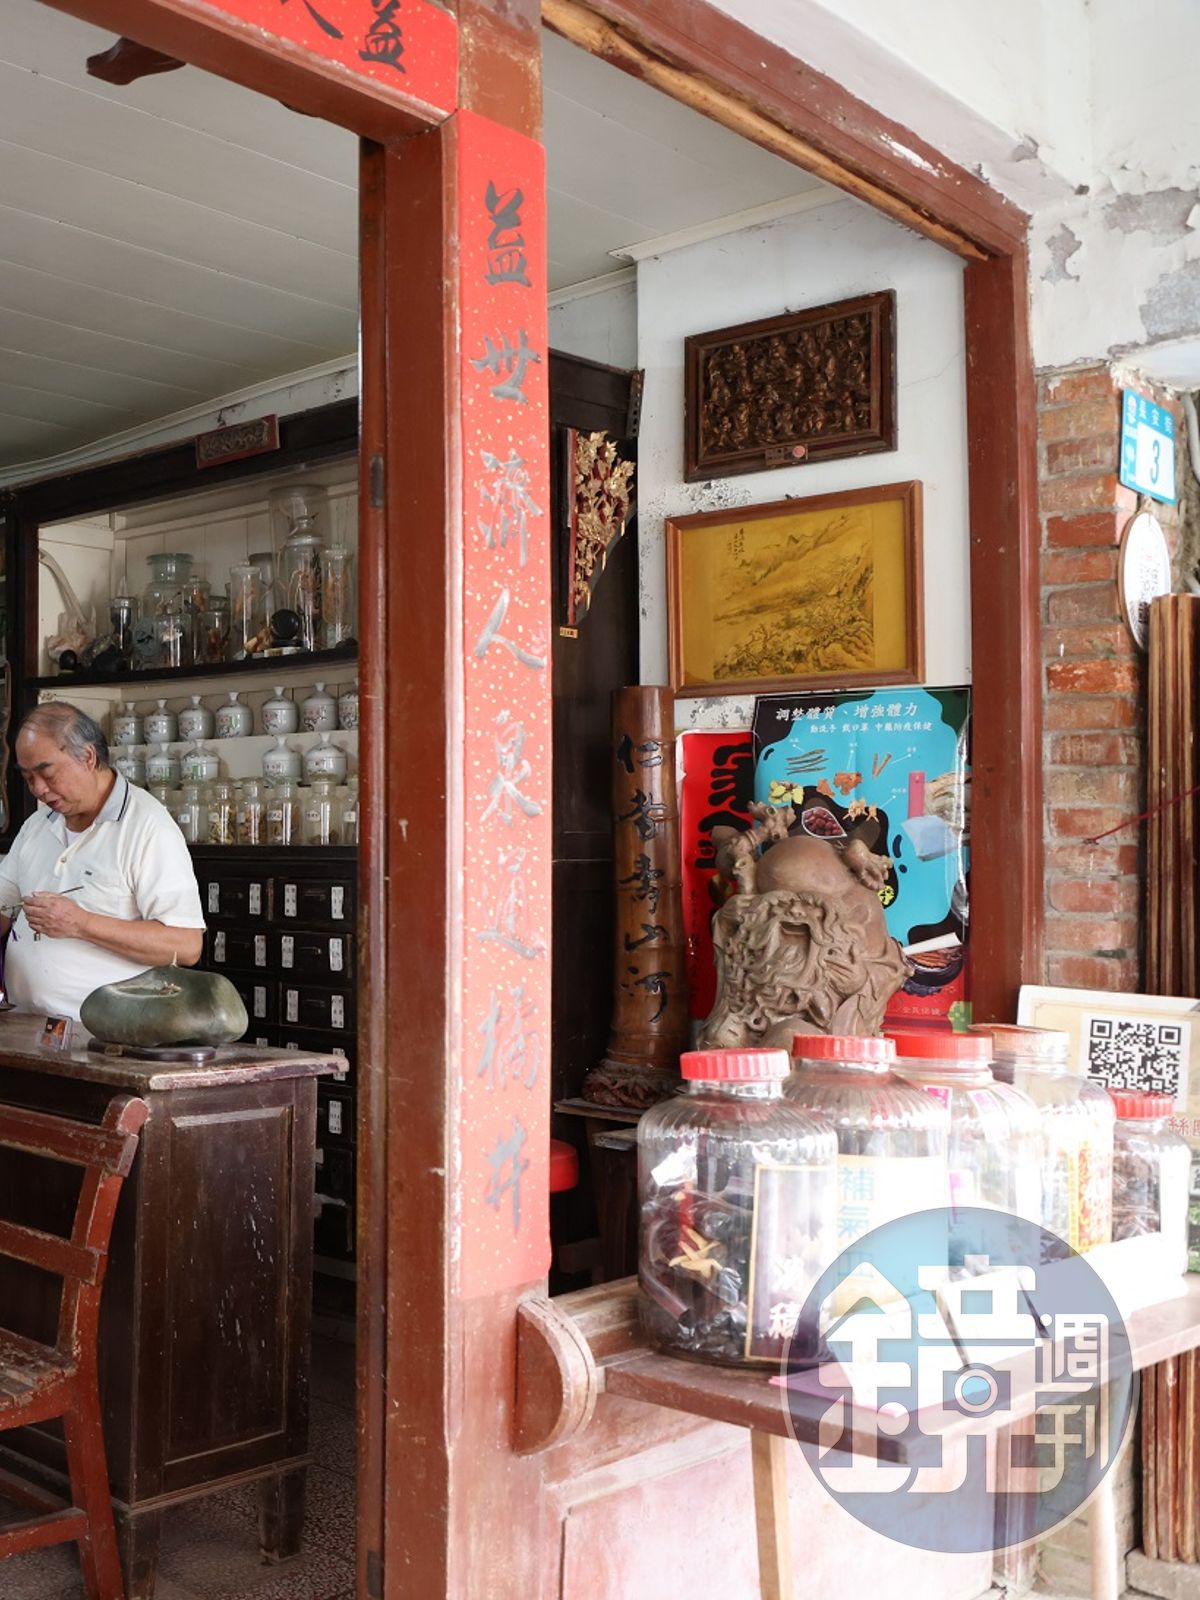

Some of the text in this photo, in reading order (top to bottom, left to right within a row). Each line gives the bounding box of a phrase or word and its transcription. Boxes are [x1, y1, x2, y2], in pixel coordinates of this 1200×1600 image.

[1150, 439, 1161, 485] 3
[776, 702, 918, 721] 調整體質、增強體力
